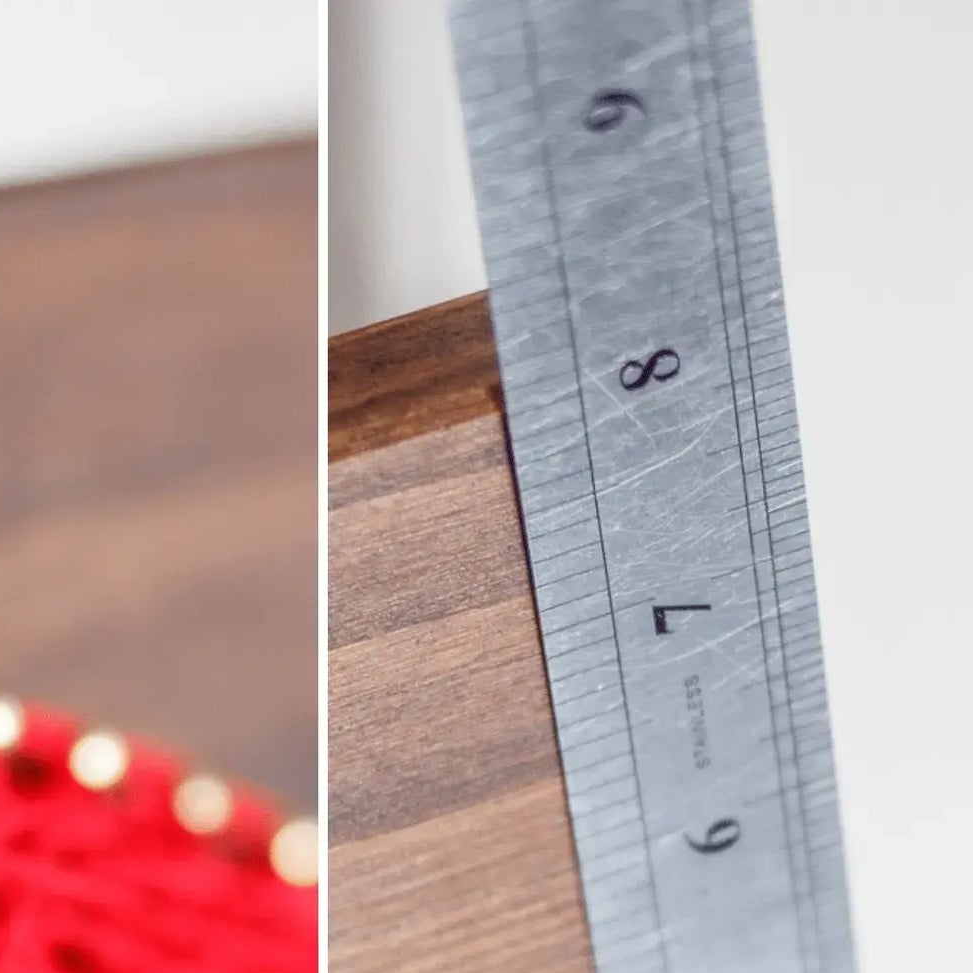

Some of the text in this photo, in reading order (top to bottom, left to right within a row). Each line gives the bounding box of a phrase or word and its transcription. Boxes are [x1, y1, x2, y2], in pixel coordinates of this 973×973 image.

[584, 87, 647, 133] 9
[619, 349, 681, 391] 8
[652, 604, 711, 636] 7
[684, 674, 712, 771] STAINLESS
[683, 818, 740, 854] 6
